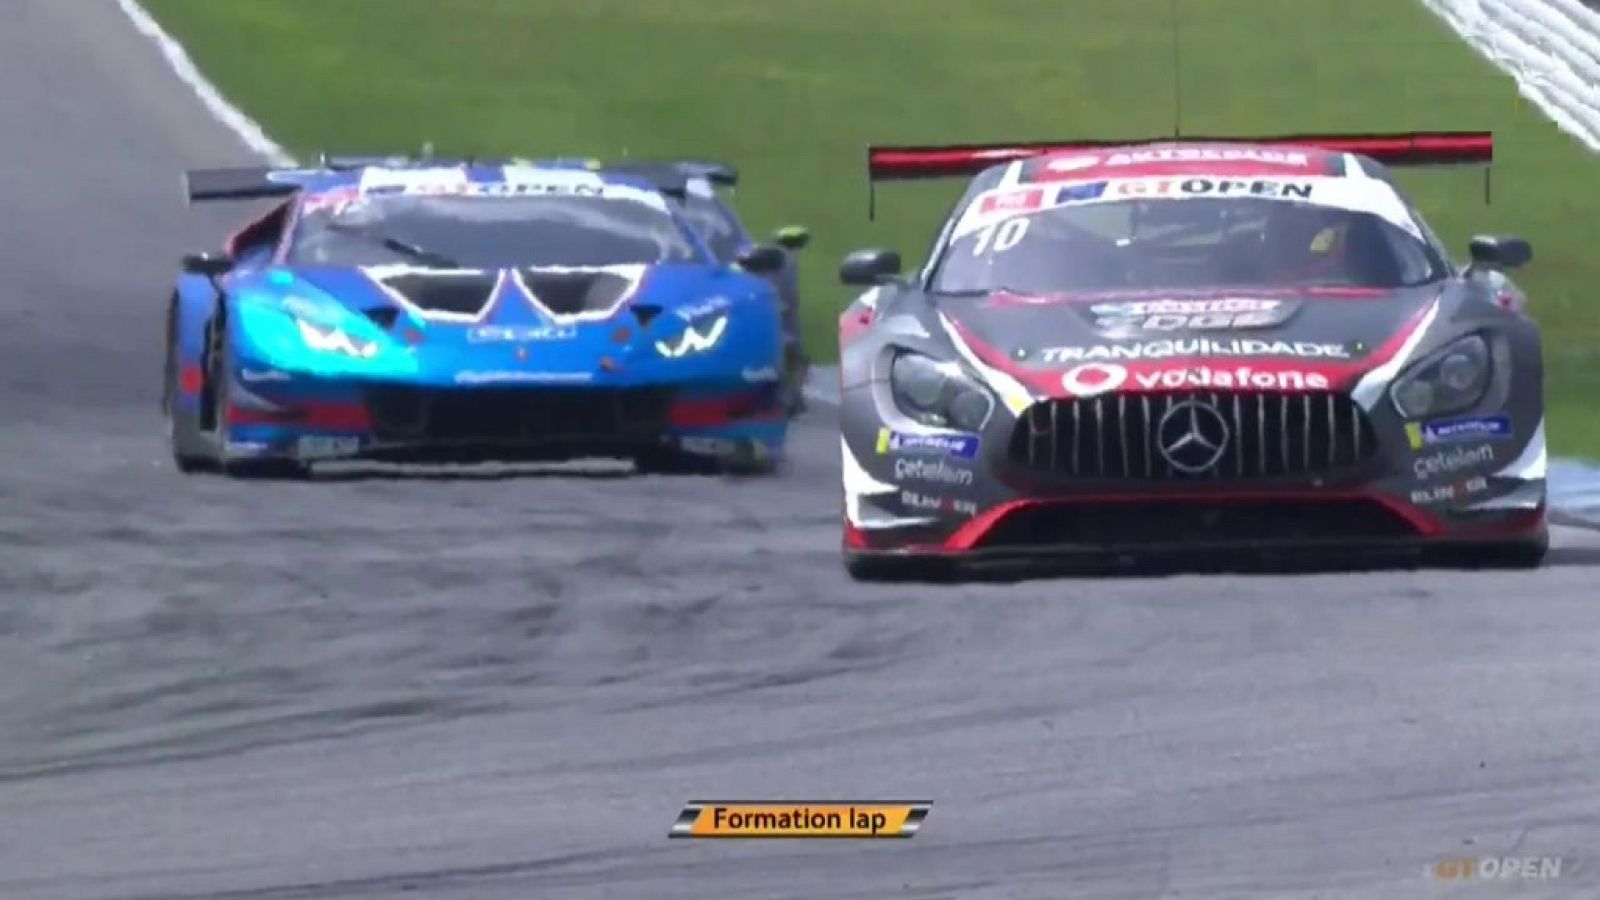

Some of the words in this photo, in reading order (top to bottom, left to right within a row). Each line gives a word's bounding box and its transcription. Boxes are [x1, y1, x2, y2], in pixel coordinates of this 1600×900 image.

[972, 217, 1030, 256] 10
[1041, 339, 1350, 362] TRANQUILIDADE
[1135, 365, 1330, 389] vodafone
